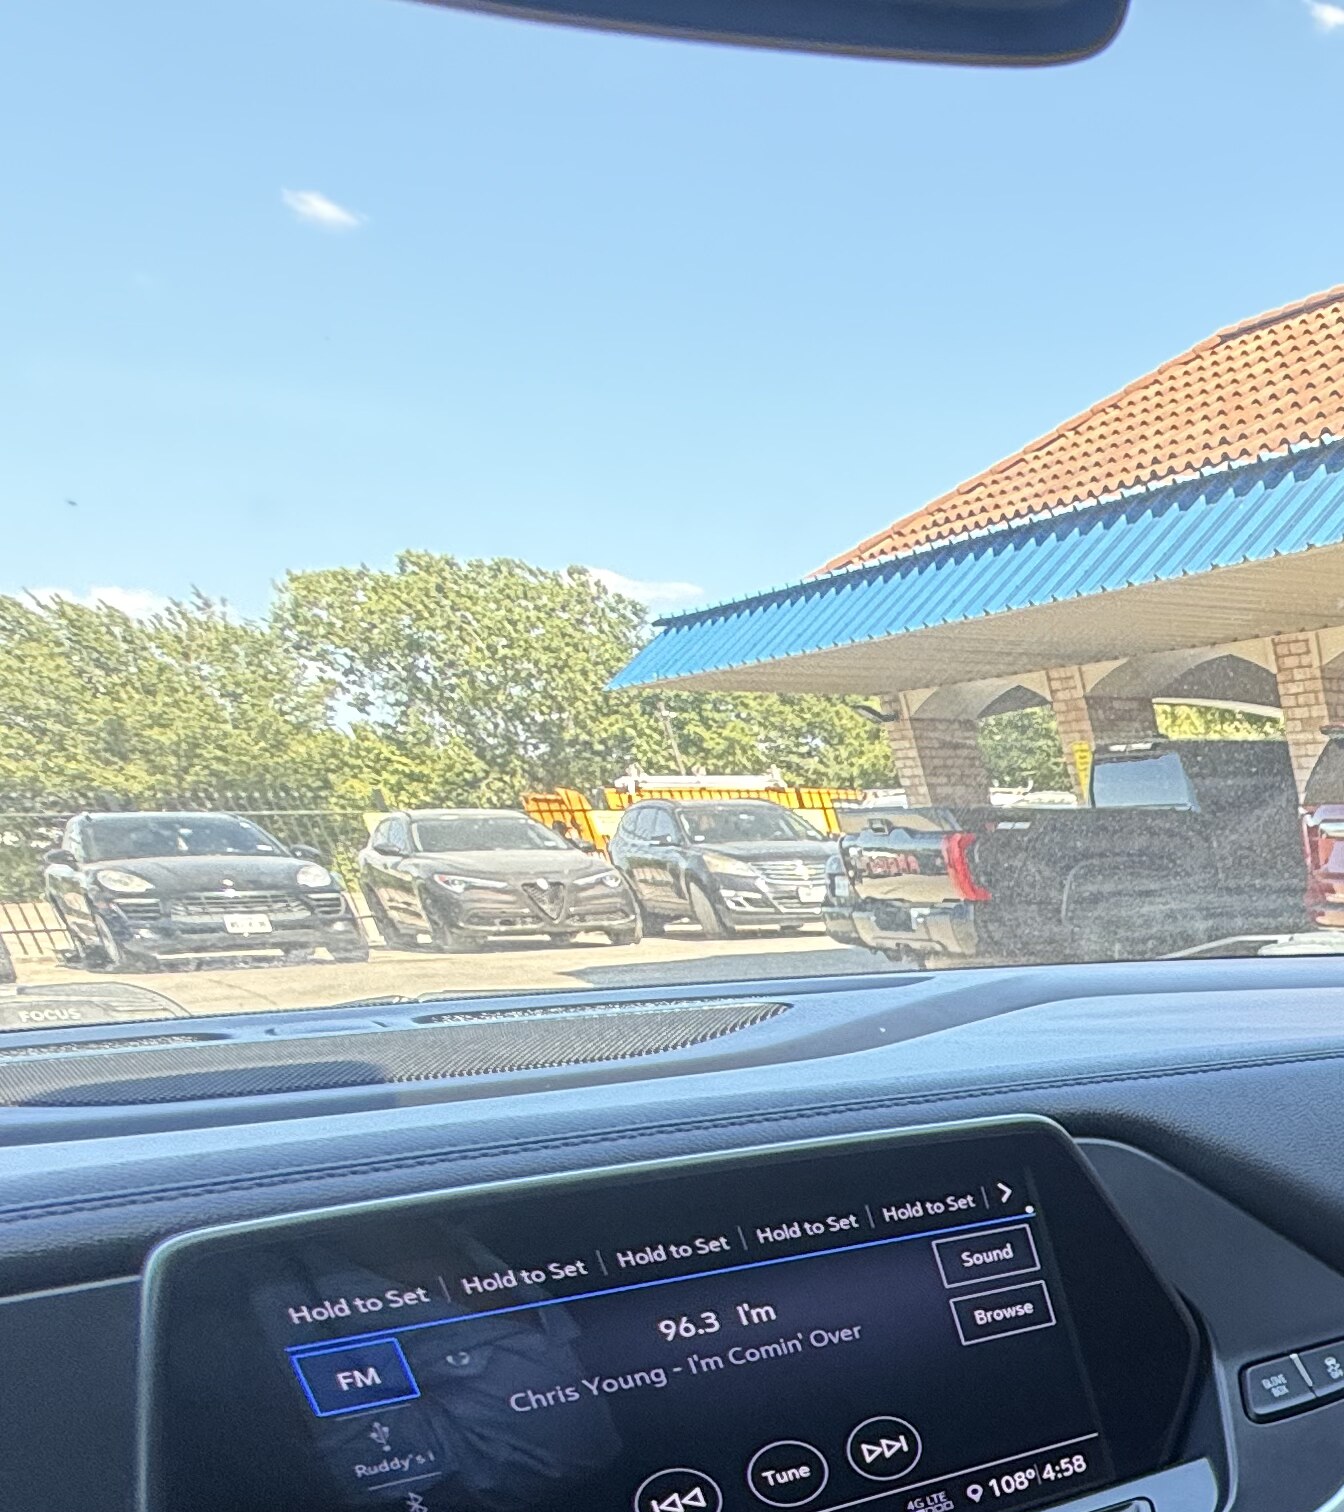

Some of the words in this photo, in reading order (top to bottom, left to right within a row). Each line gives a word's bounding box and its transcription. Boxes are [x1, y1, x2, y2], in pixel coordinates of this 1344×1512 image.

[19, 1008, 81, 1022] FOCUS
[883, 1202, 923, 1221] Hold
[926, 1202, 944, 1214] to
[946, 1195, 975, 1210] Set
[757, 1222, 801, 1243] Hold
[804, 1222, 824, 1235] to
[826, 1215, 859, 1231] Set
[617, 1245, 666, 1267] Hold
[669, 1245, 692, 1258] to
[695, 1237, 730, 1254] Set
[961, 1243, 1013, 1266] Sound
[462, 1270, 516, 1294] Hold
[520, 1270, 546, 1284] to
[549, 1261, 588, 1279] Set
[288, 1298, 351, 1324] Hold
[355, 1298, 382, 1312] to
[385, 1288, 430, 1307] Set
[974, 1303, 1033, 1324] Browse
[658, 1312, 719, 1341] 96.3
[737, 1304, 776, 1325] I'm
[337, 1368, 381, 1390] FM
[510, 1386, 579, 1411] Chris
[582, 1367, 668, 1395] Young
[687, 1355, 723, 1374] I'm
[728, 1333, 803, 1364] Comin'
[810, 1326, 860, 1347] Over
[355, 1452, 427, 1479] Ruddy's
[762, 1466, 810, 1485] Tune
[989, 1469, 1035, 1496] 108°
[1043, 1455, 1086, 1480] 4:58
[906, 1499, 924, 1512] 4G
[926, 1491, 947, 1506] LTE
